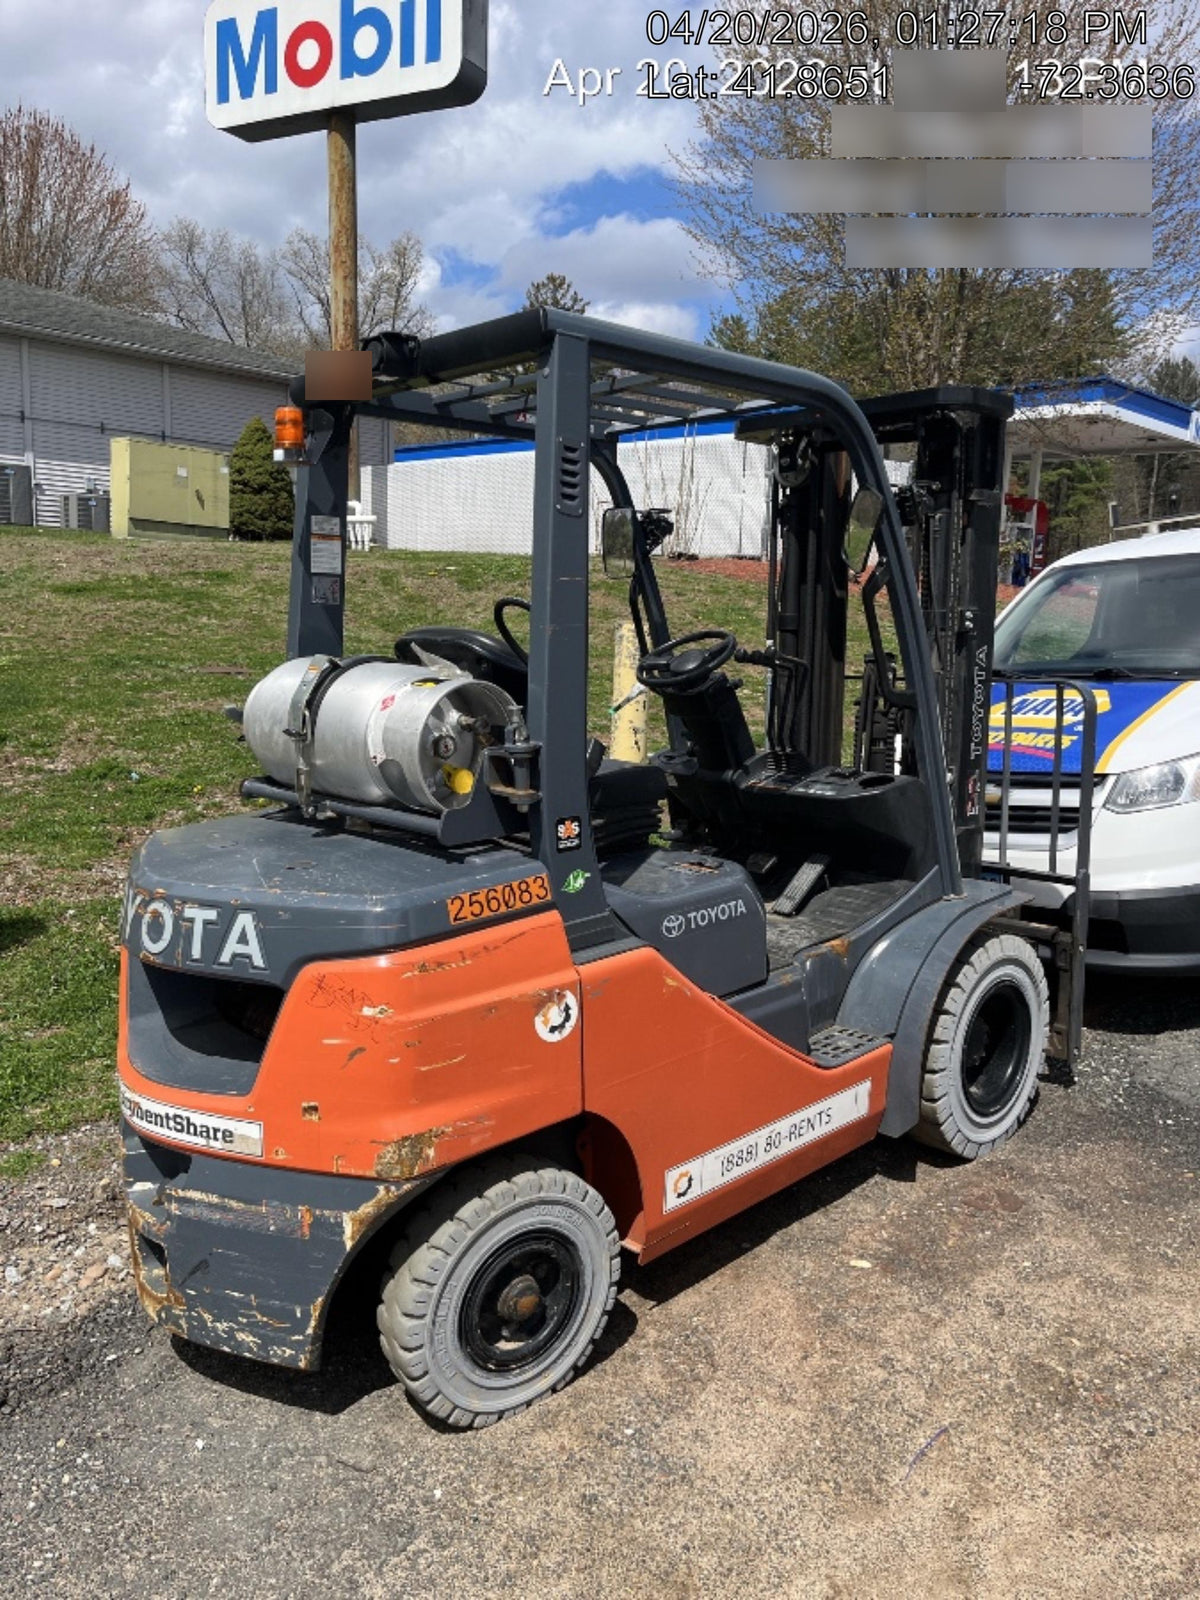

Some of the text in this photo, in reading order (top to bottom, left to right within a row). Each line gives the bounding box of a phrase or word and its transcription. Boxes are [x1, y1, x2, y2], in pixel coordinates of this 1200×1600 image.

[216, 0, 442, 105] Mobil
[970, 645, 988, 760] TOYOTA
[123, 887, 266, 968] YOTA
[450, 875, 549, 923] 256083
[687, 899, 747, 929] TOYOTA
[721, 1107, 833, 1177] (888) 80-RENTS
